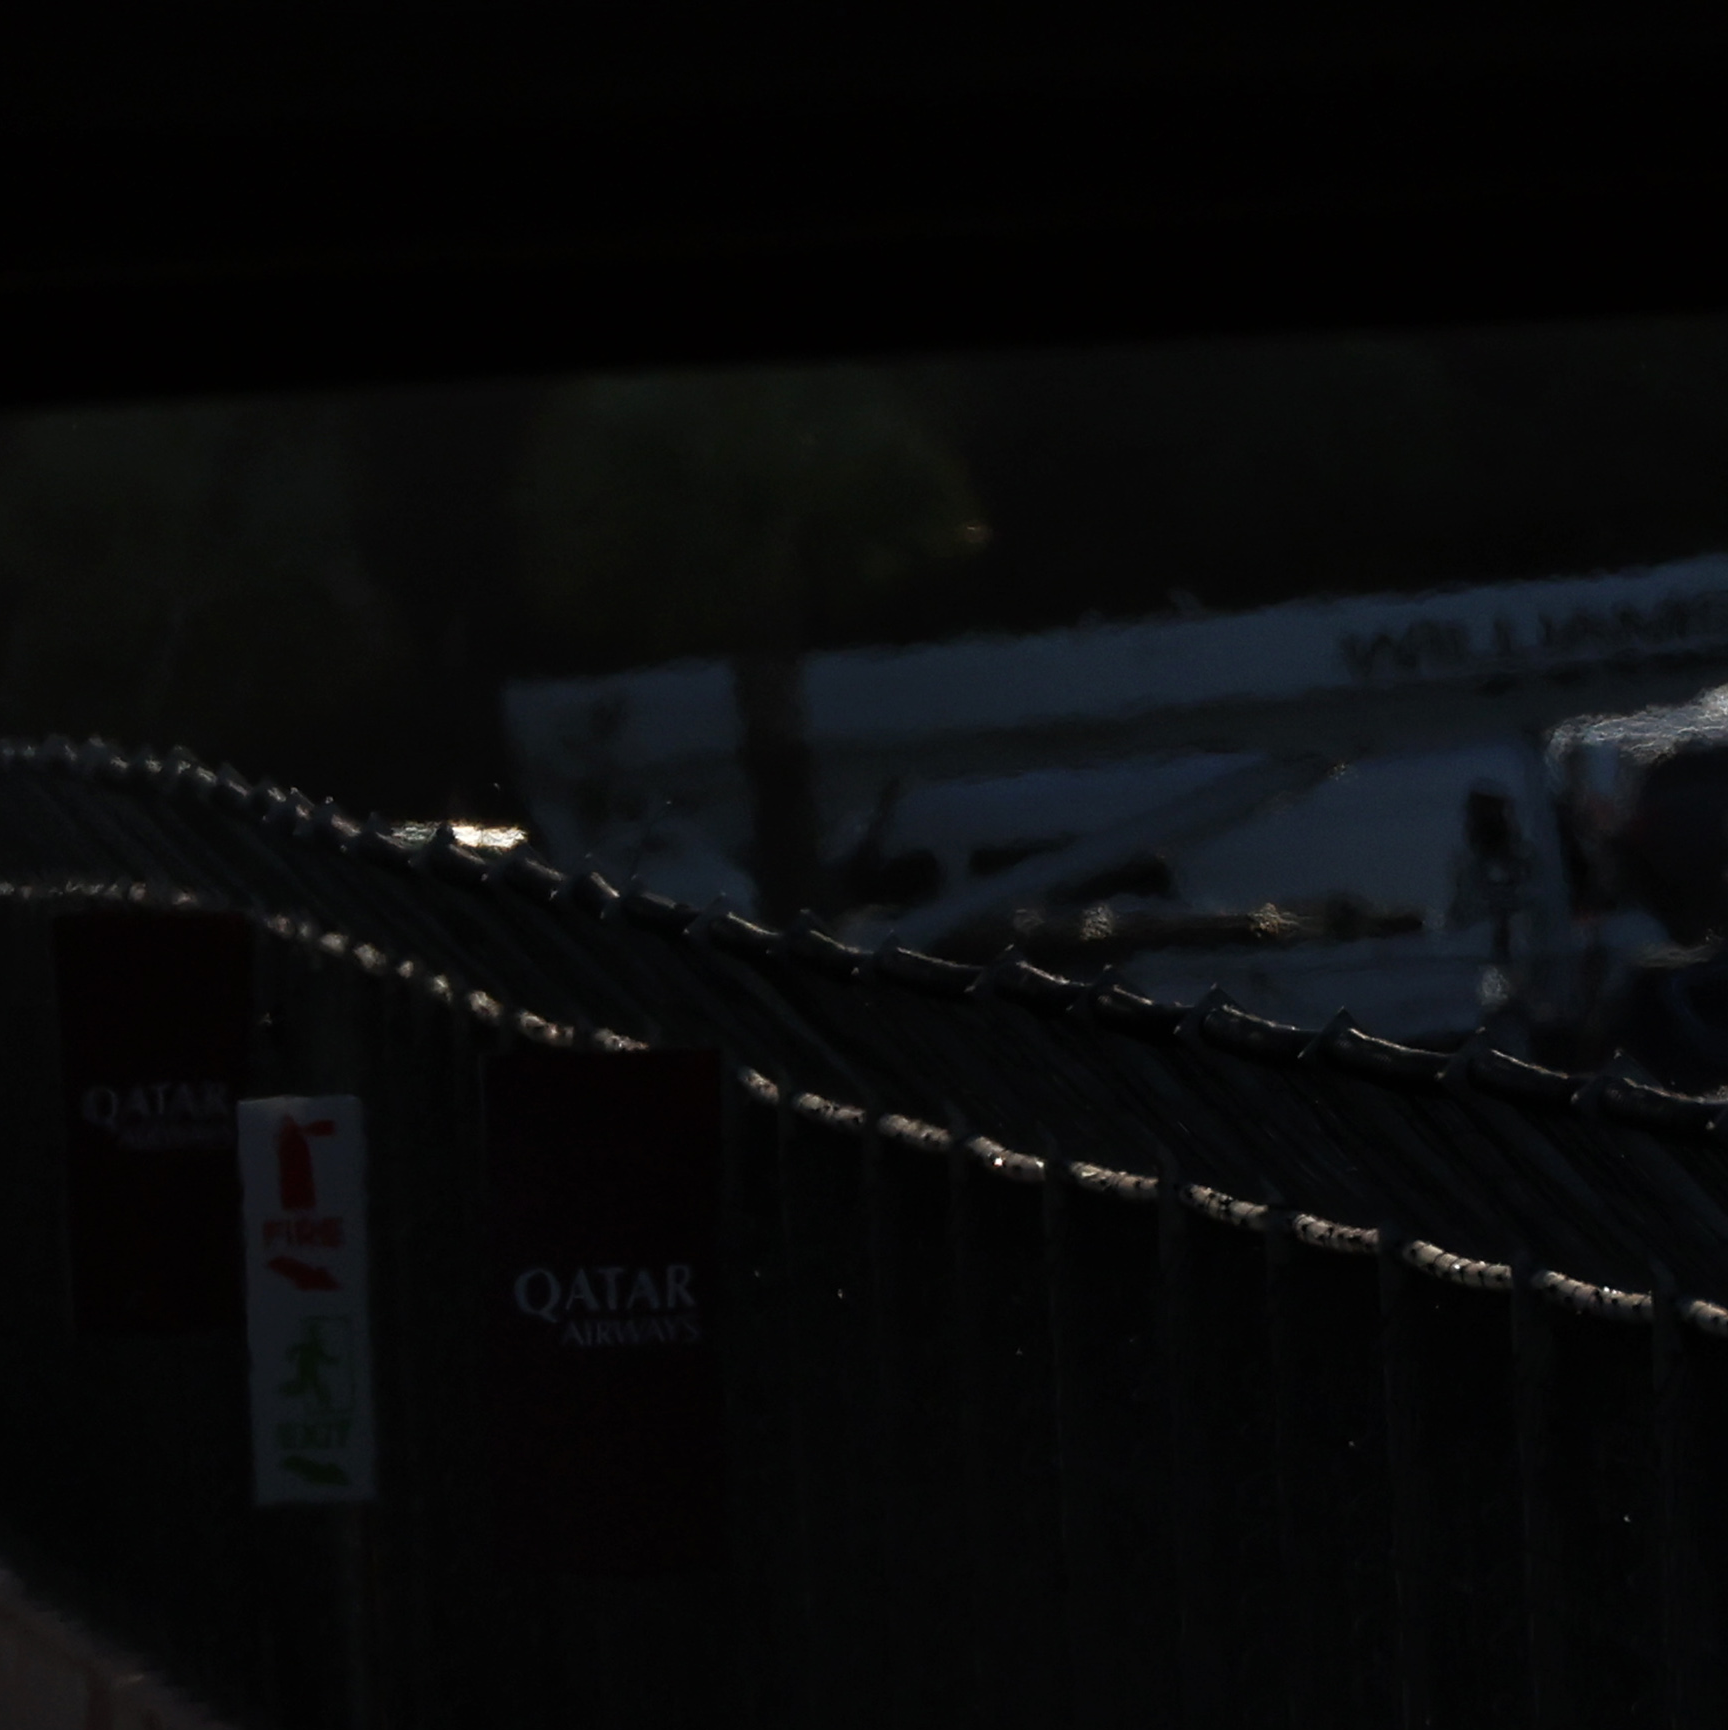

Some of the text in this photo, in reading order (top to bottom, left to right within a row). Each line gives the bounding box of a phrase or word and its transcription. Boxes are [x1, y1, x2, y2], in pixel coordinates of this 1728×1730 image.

[79, 1079, 231, 1134] QATAR
[262, 1217, 341, 1248] FIRE
[513, 1263, 696, 1323] QATAR
[561, 1314, 701, 1348] AIRWAYS
